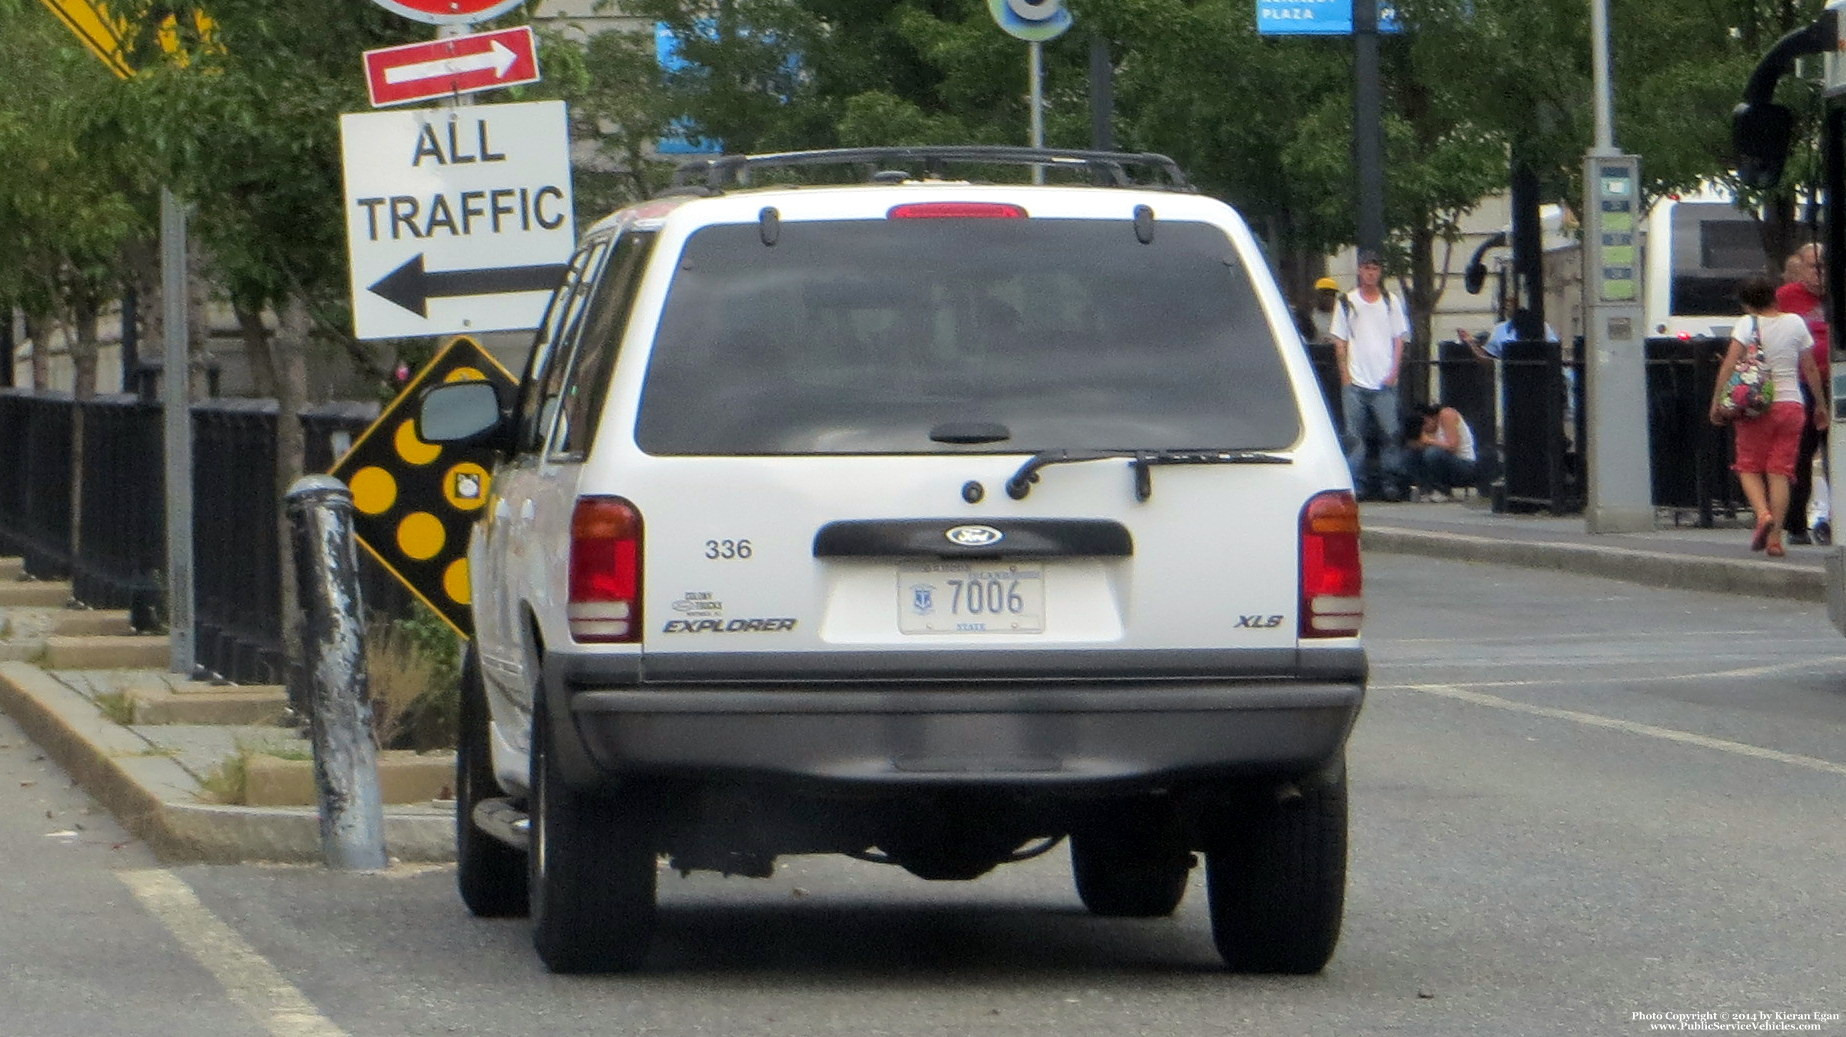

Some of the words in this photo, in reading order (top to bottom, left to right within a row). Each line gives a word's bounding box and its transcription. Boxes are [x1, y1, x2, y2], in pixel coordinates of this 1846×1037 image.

[1262, 8, 1314, 19] PLAZA
[412, 119, 507, 167] ALL
[357, 185, 564, 240] TRAFFIC
[705, 539, 752, 559] 336
[947, 579, 1024, 614] 7006
[662, 618, 797, 632] EXPLORER
[956, 623, 986, 632] STATE
[1233, 615, 1284, 628] XLS
